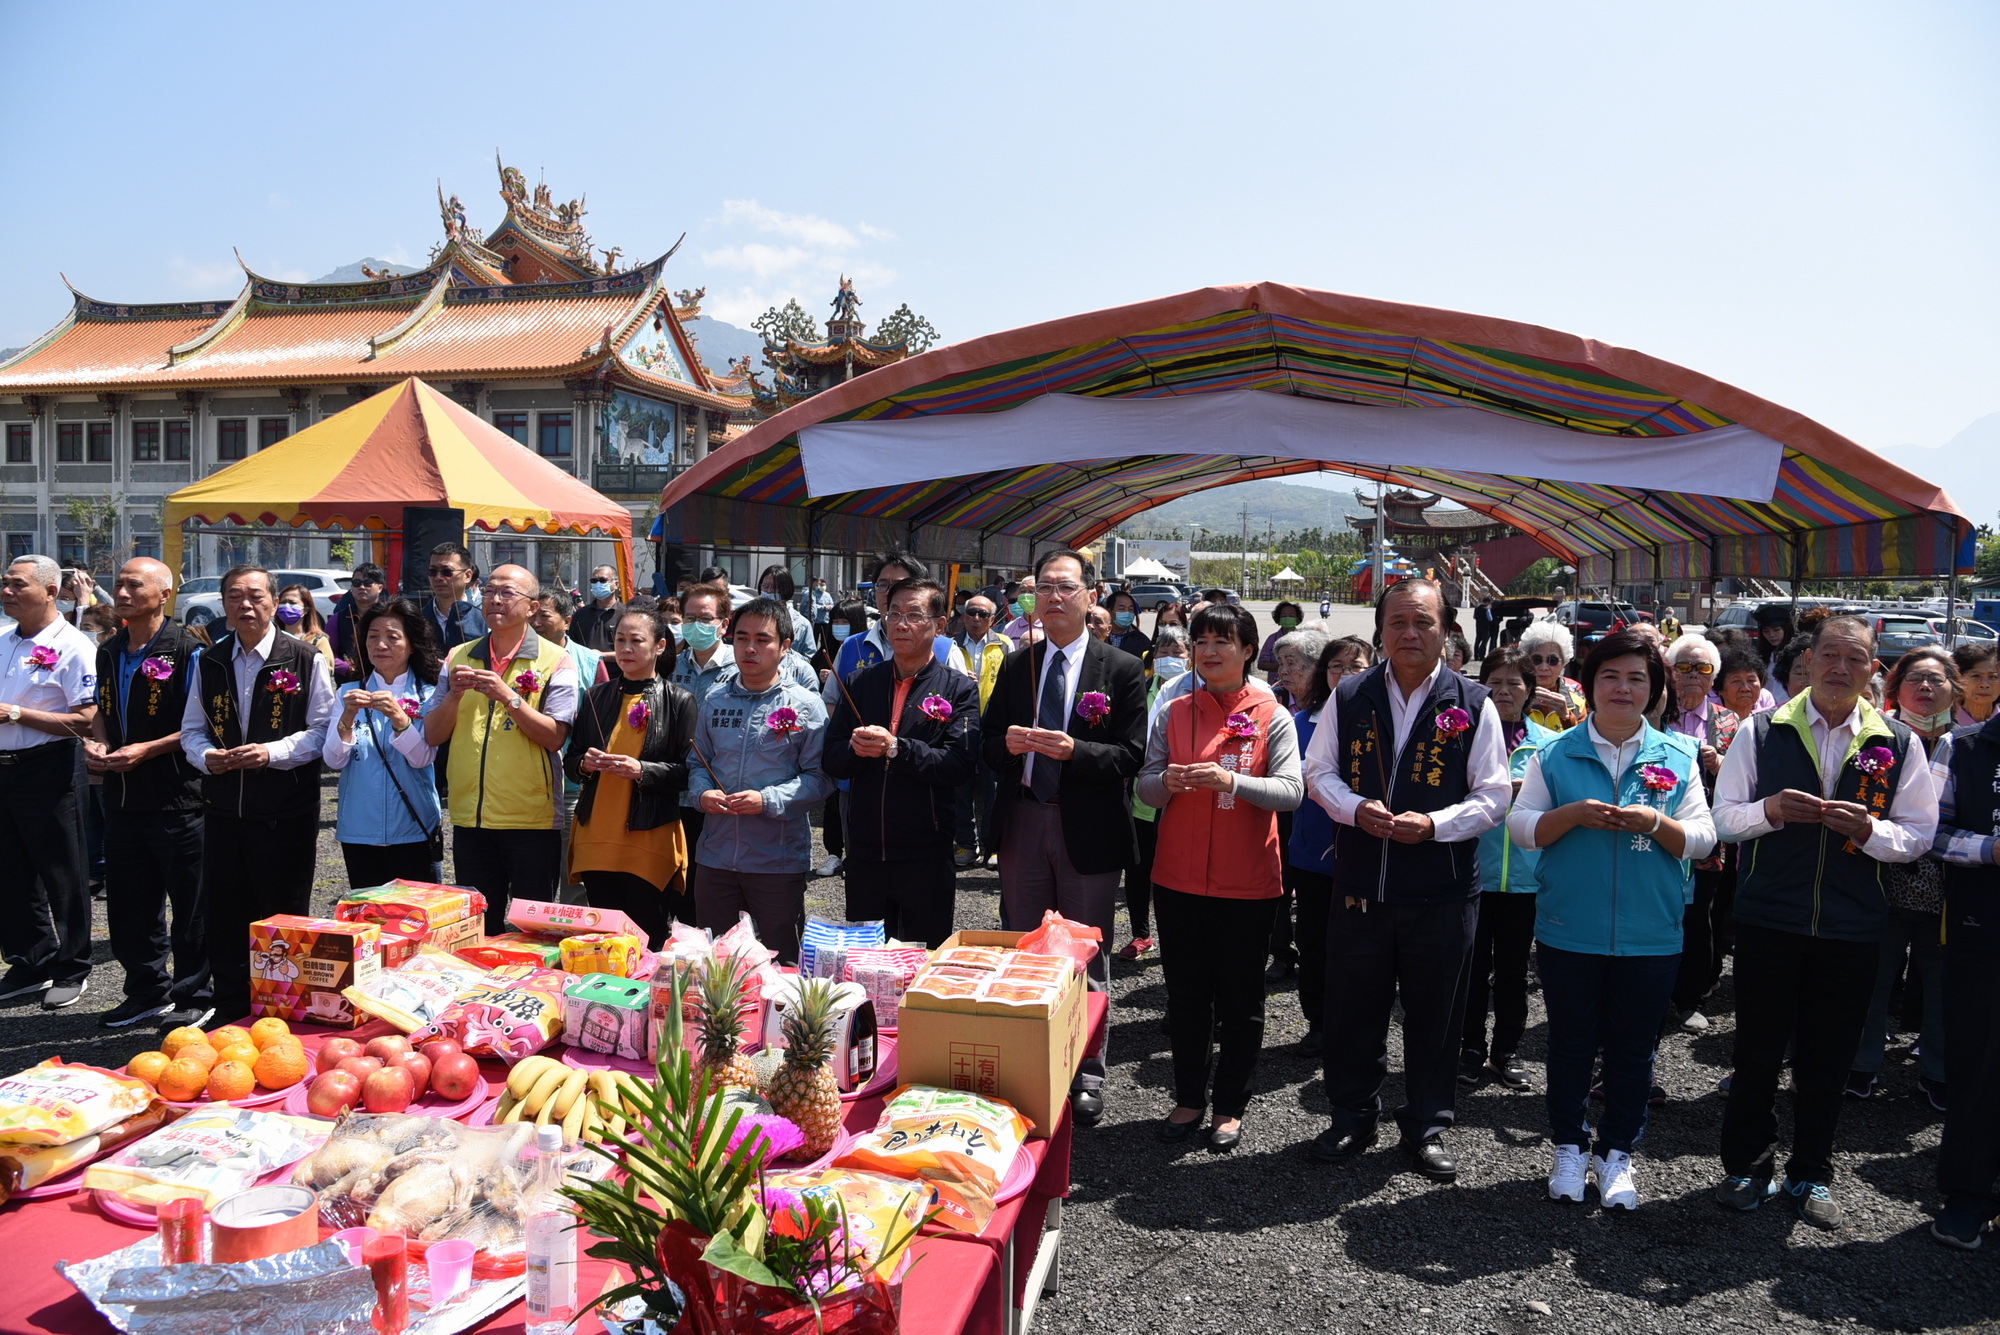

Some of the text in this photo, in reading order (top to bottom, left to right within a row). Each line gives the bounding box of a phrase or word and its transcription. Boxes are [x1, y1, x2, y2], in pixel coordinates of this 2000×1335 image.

[270, 692, 284, 729] 武昌宮
[303, 970, 335, 979] MR.BROWN
[308, 976, 329, 984] COFFEE
